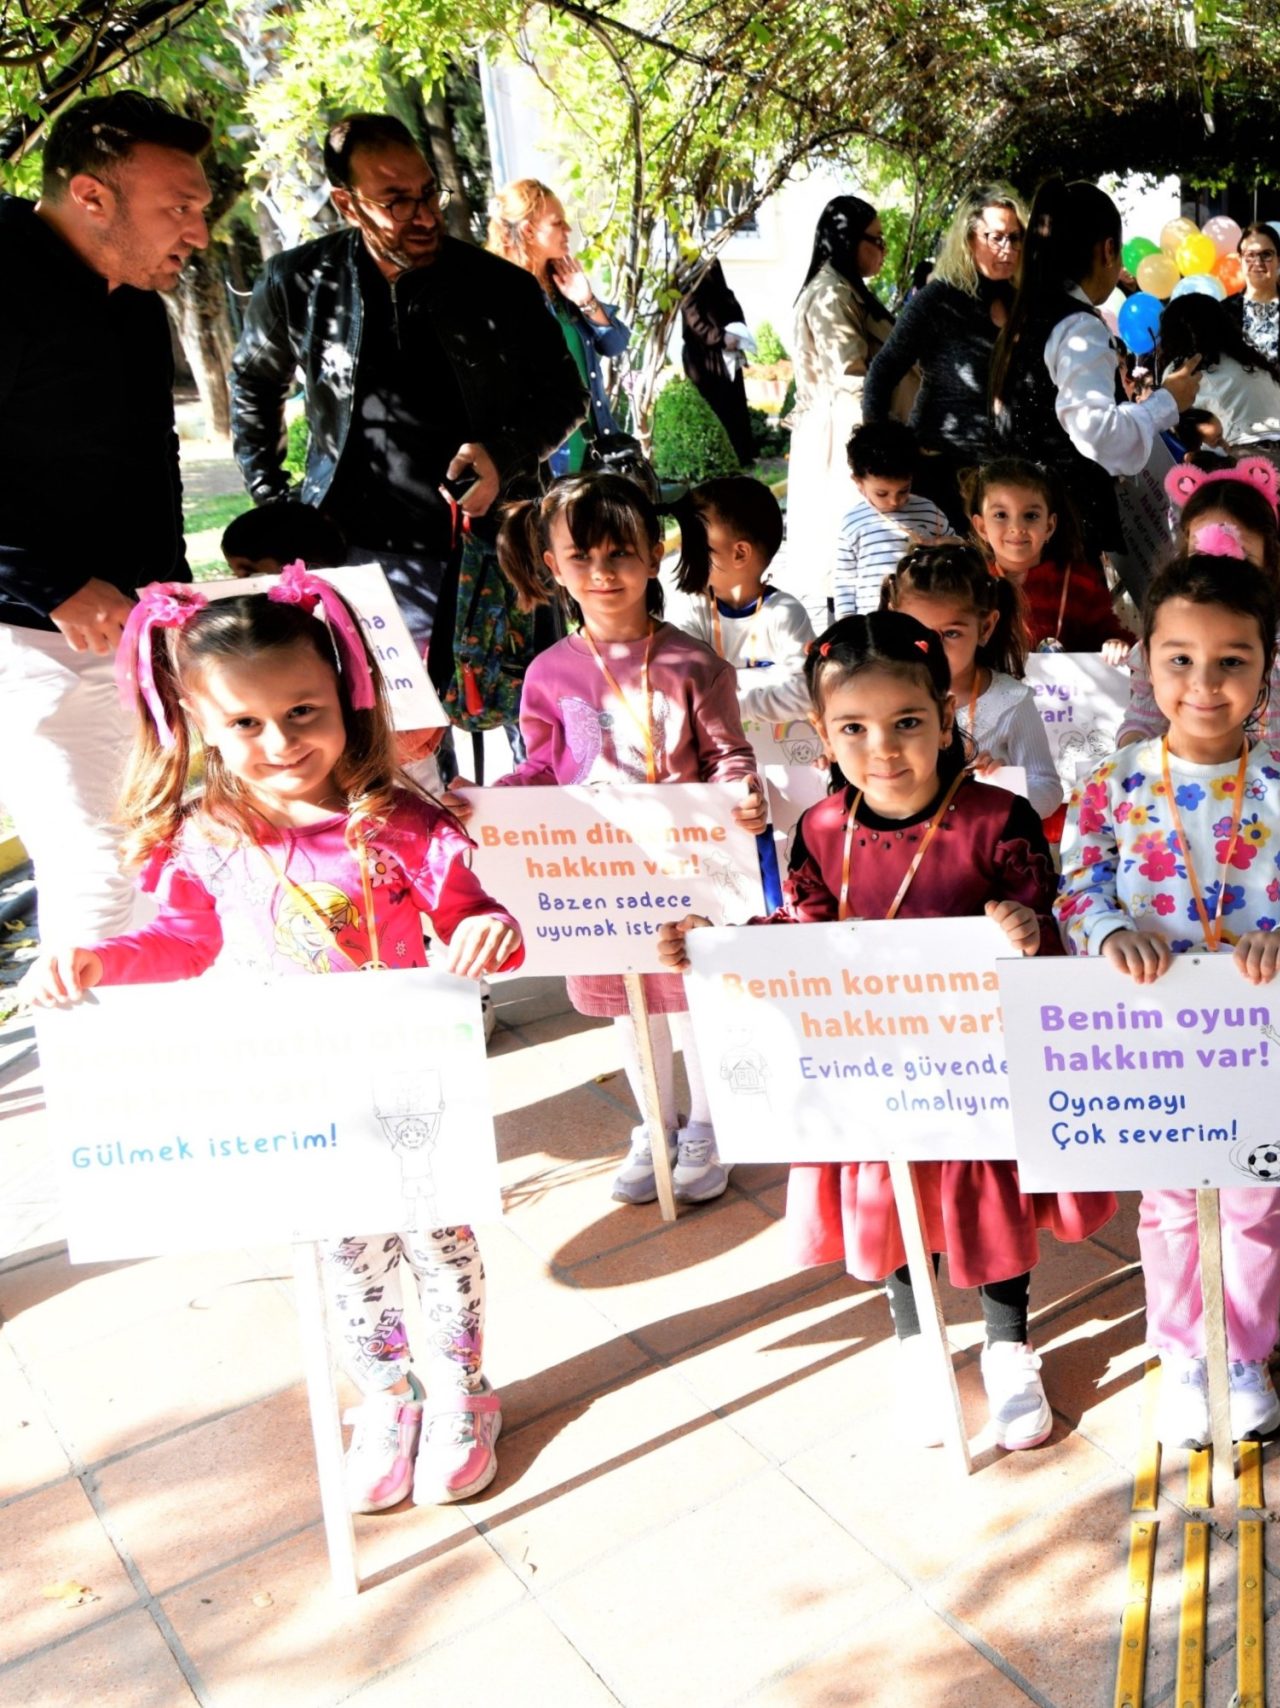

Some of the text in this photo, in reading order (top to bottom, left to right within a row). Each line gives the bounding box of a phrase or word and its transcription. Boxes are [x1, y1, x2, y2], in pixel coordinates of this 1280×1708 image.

[1034, 680, 1078, 701] evgi
[480, 822, 727, 847] Benim dinnme
[526, 856, 635, 879] hakkım
[538, 891, 692, 911] Bazen sadece
[536, 919, 617, 941] uyumak
[722, 968, 999, 998] Benim korunma
[800, 1010, 929, 1038] hakkım
[1040, 1002, 1270, 1034] Benim oyun
[799, 1056, 894, 1079] Evimde
[1044, 1041, 1269, 1071] hakkım var!
[1049, 1090, 1186, 1117] Oynamayı
[72, 1123, 338, 1170] Gülmek isterim!
[1051, 1119, 1237, 1150] Çok severim!
